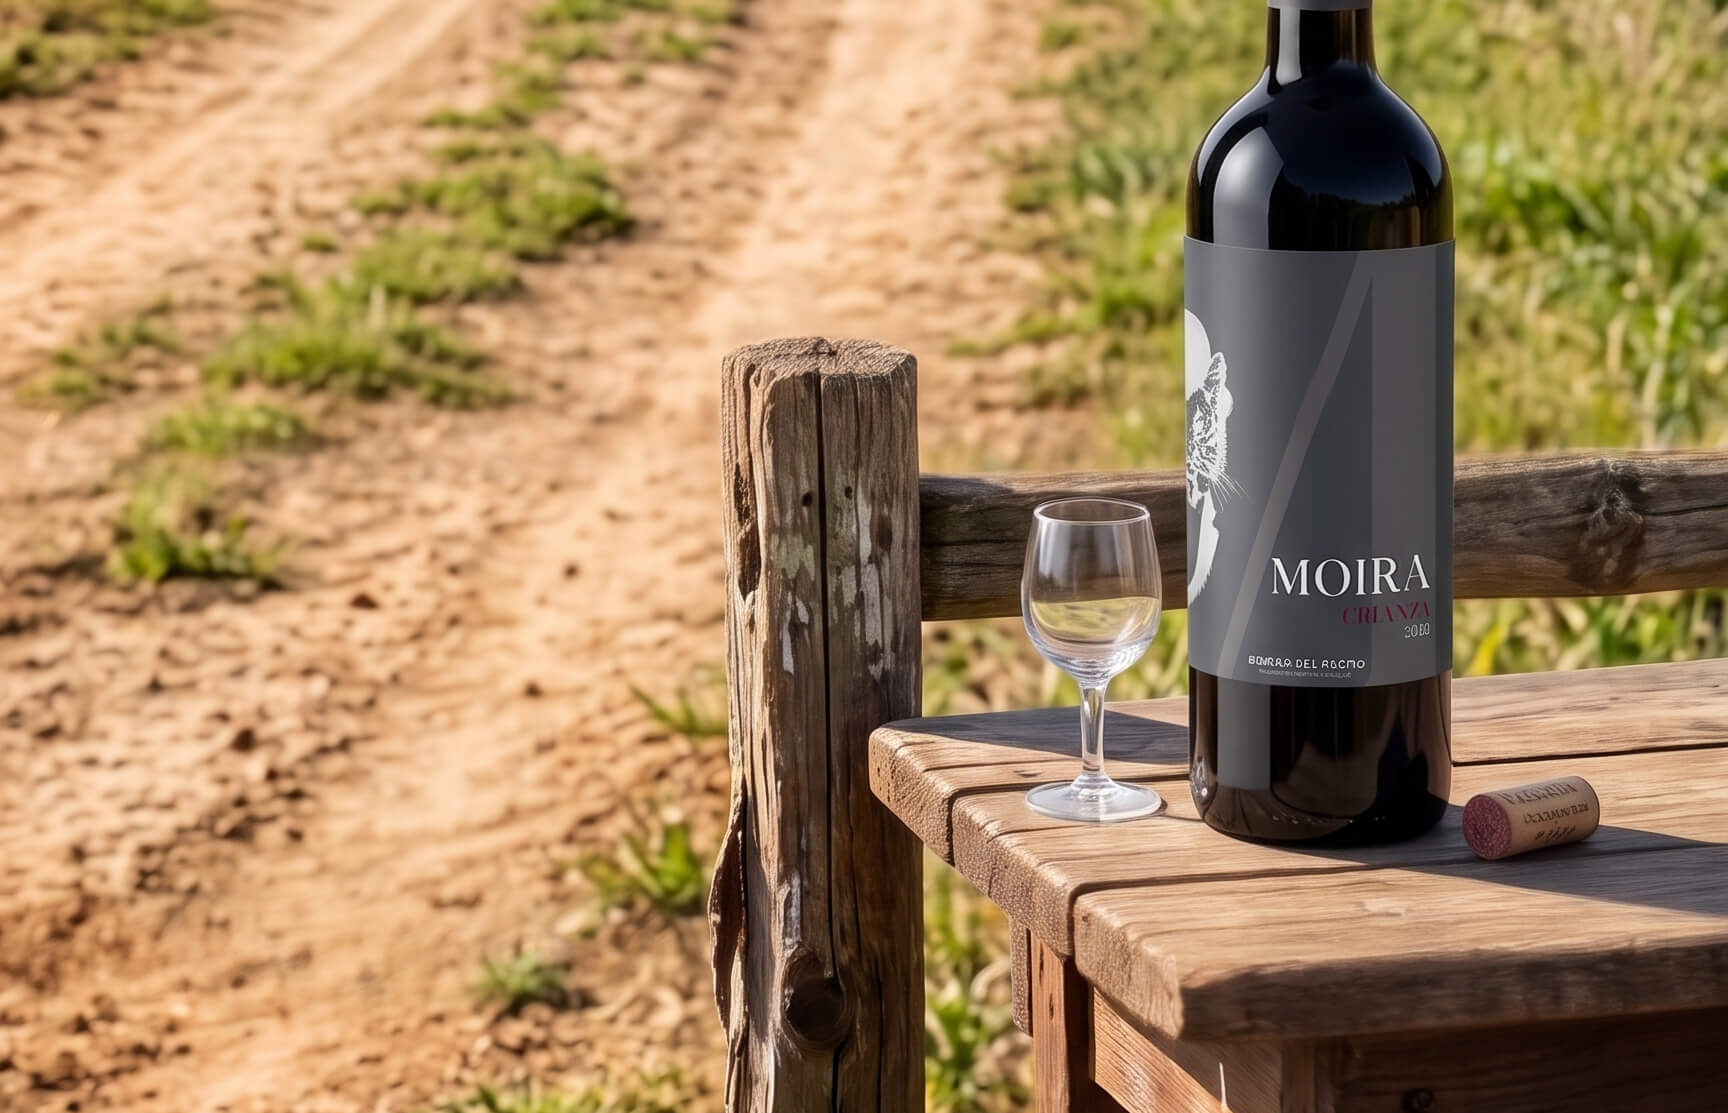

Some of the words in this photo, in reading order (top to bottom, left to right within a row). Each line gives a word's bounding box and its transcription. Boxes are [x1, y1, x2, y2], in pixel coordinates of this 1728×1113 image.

[1271, 554, 1430, 596] MOIRA
[1341, 600, 1430, 624] CRIANZA
[1296, 658, 1318, 669] DEL
